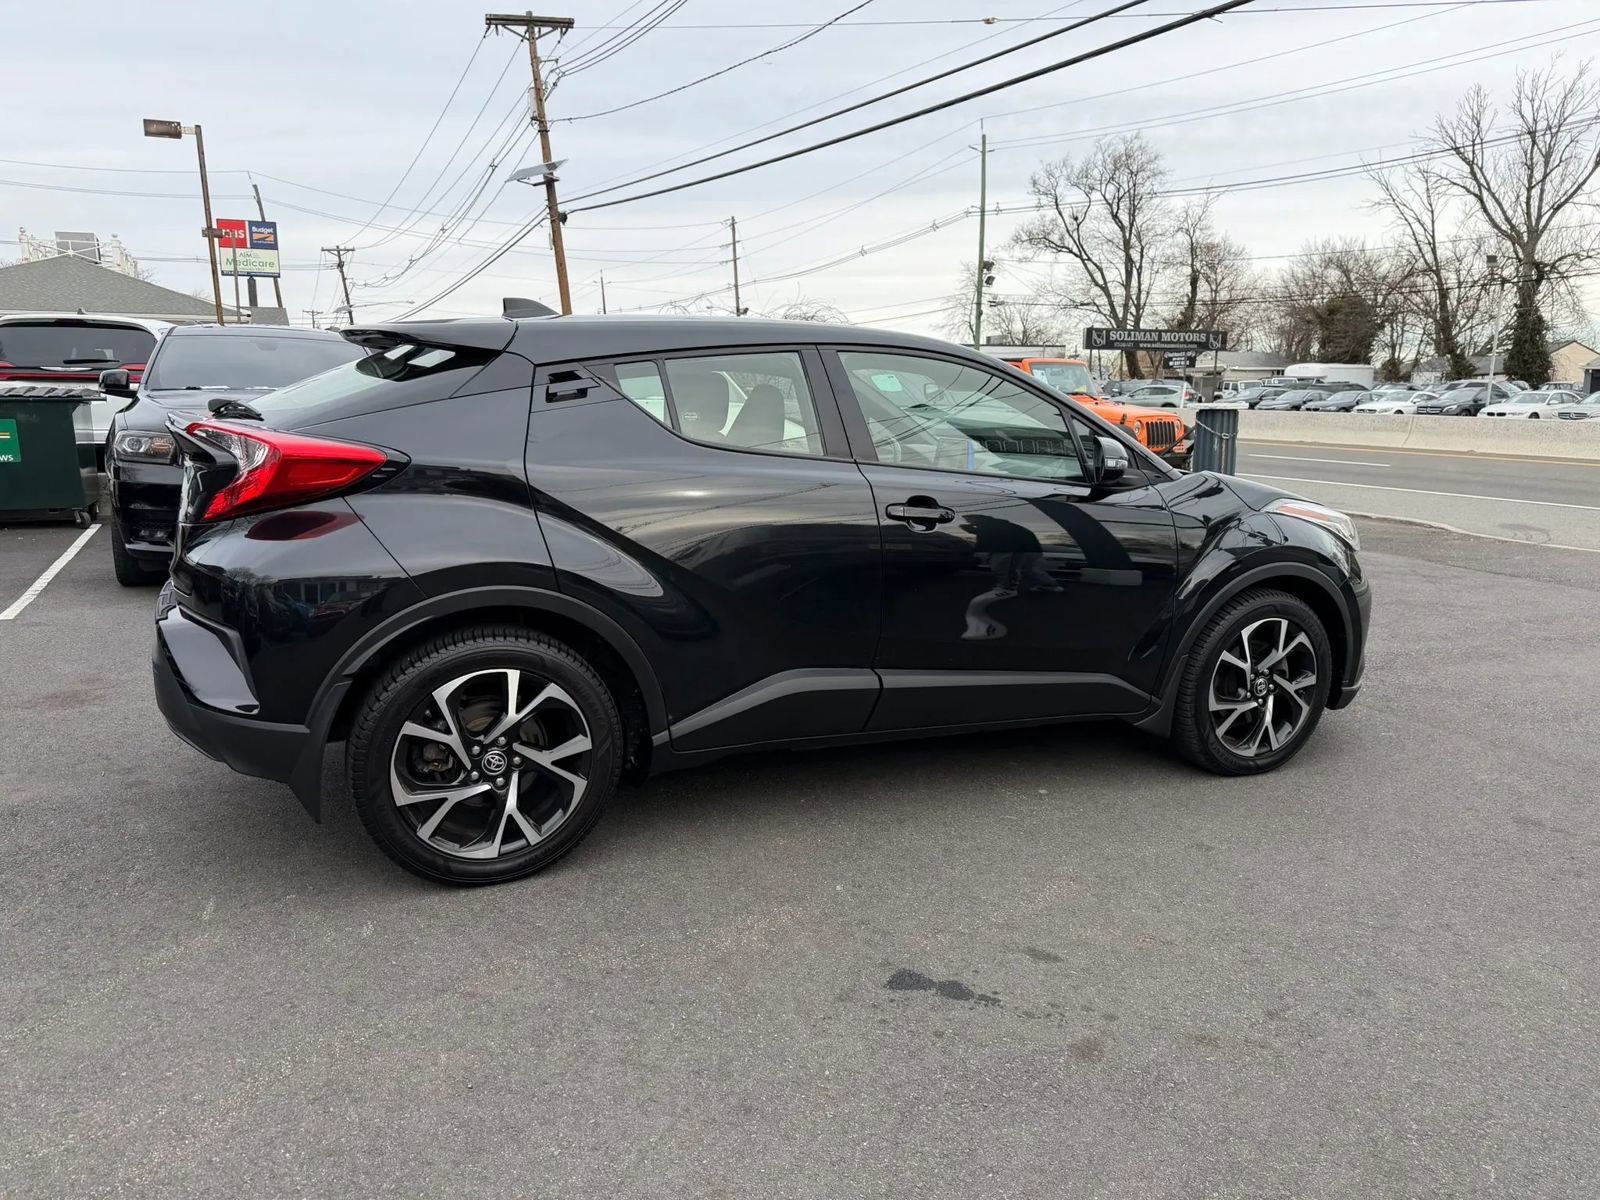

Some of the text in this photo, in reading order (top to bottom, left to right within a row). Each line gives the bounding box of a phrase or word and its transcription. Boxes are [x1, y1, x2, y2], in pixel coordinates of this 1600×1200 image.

[252, 226, 273, 234] Budget
[225, 258, 275, 268] Medicare
[1109, 330, 1159, 341] SOLIMAN
[1161, 332, 1207, 342] MOTORS
